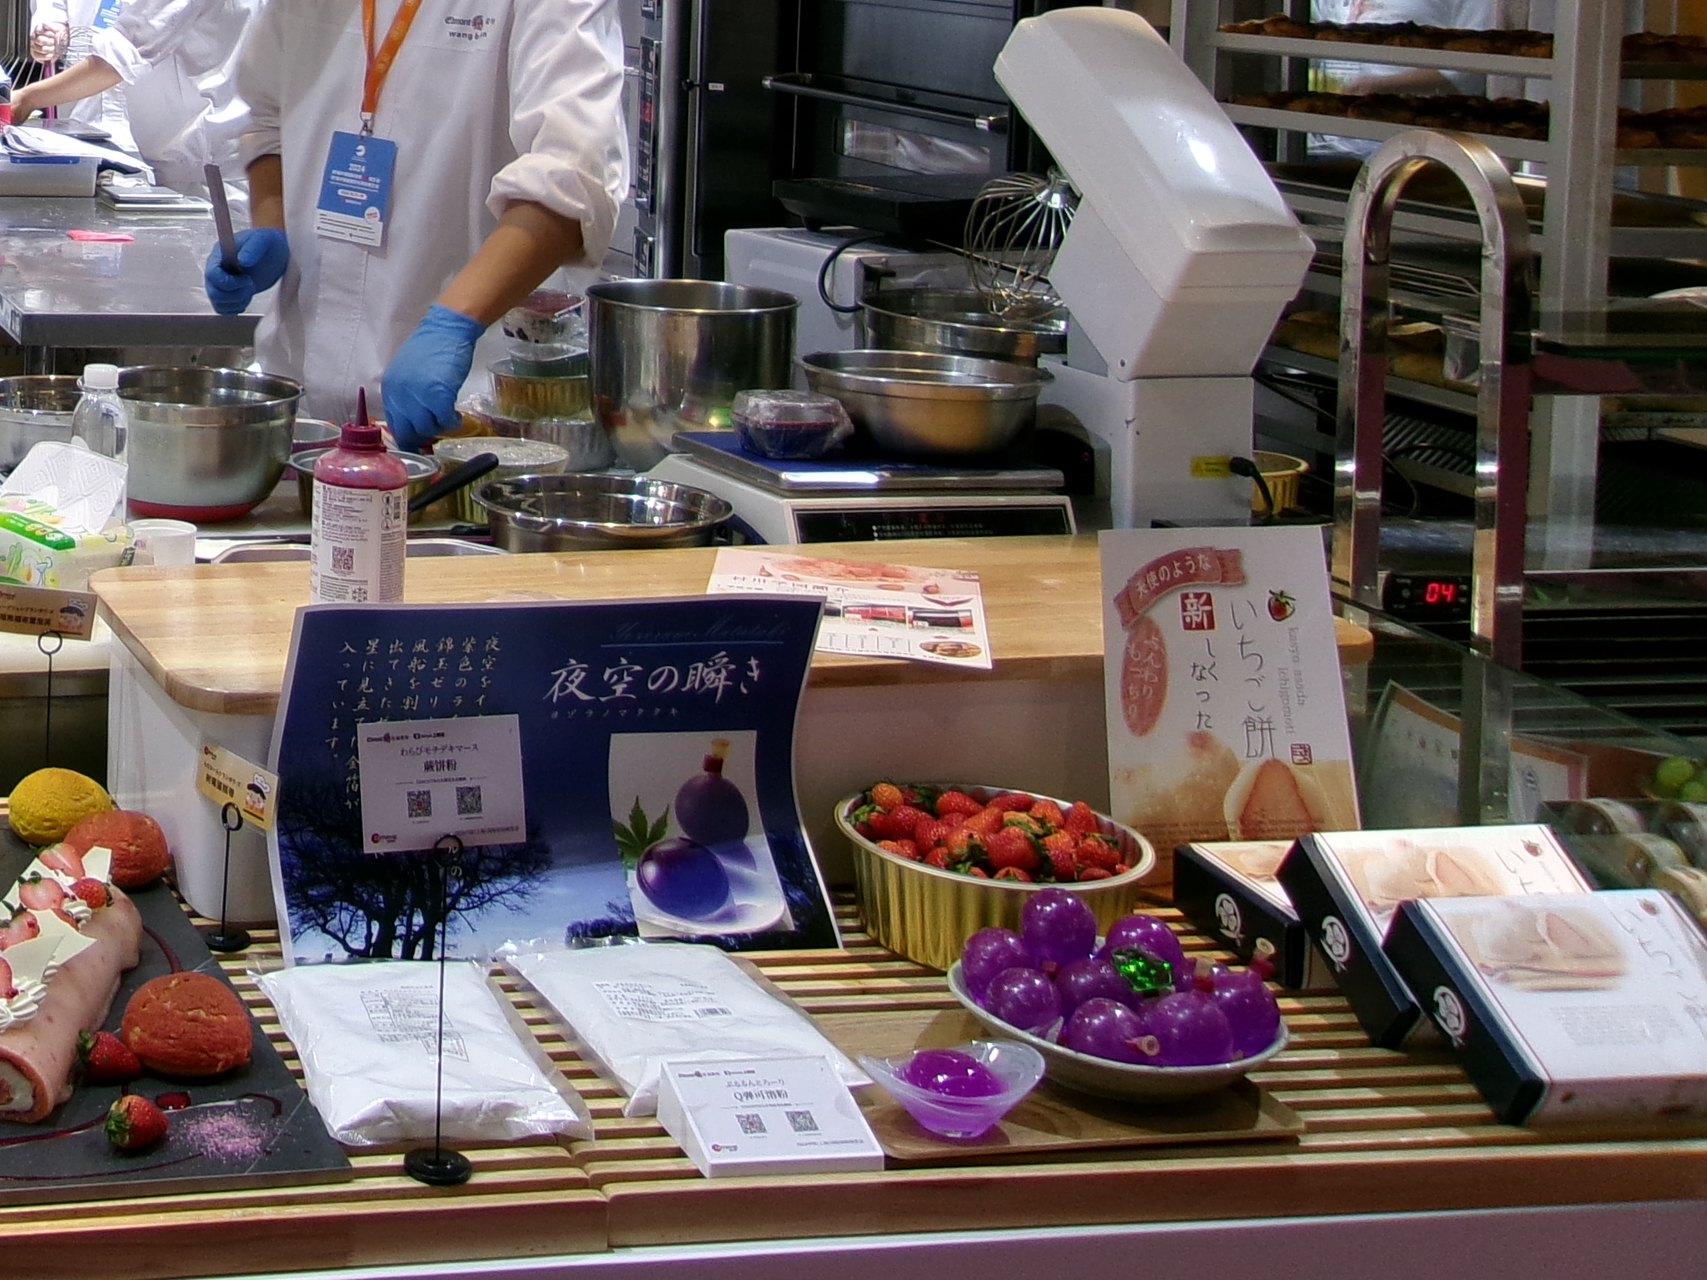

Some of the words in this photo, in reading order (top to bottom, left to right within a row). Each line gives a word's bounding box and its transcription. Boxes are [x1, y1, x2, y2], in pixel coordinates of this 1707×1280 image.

[1135, 552, 1212, 597] 天使のような
[1426, 583, 1454, 603] 04
[543, 651, 760, 704] 夜空の瞬き
[400, 743, 479, 757] わらびモチデキマース
